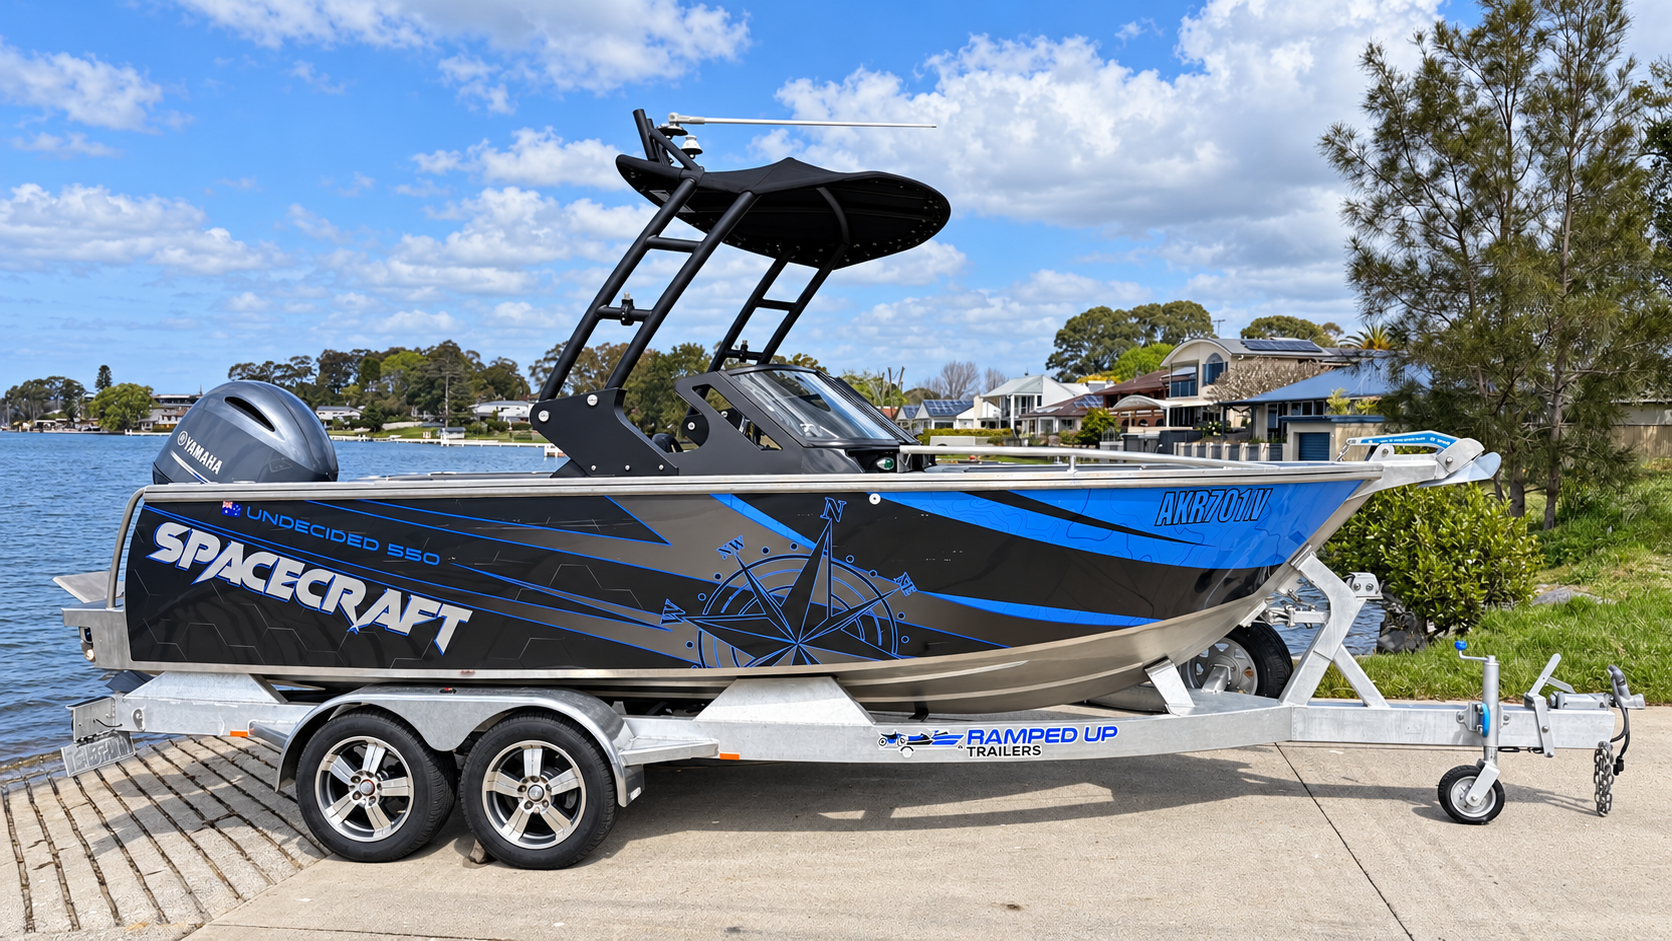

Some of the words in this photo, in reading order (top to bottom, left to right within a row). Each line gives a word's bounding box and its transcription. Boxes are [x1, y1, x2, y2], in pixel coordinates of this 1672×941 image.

[184, 436, 223, 475] YAMAHA
[820, 496, 847, 523] N
[246, 506, 380, 551] UNDECIDED
[387, 543, 441, 566] 550
[145, 521, 473, 655] SPACECRAFT
[966, 726, 1079, 745] RAMPED
[1084, 726, 1118, 742] UP
[966, 745, 1042, 757] TRAILERS
